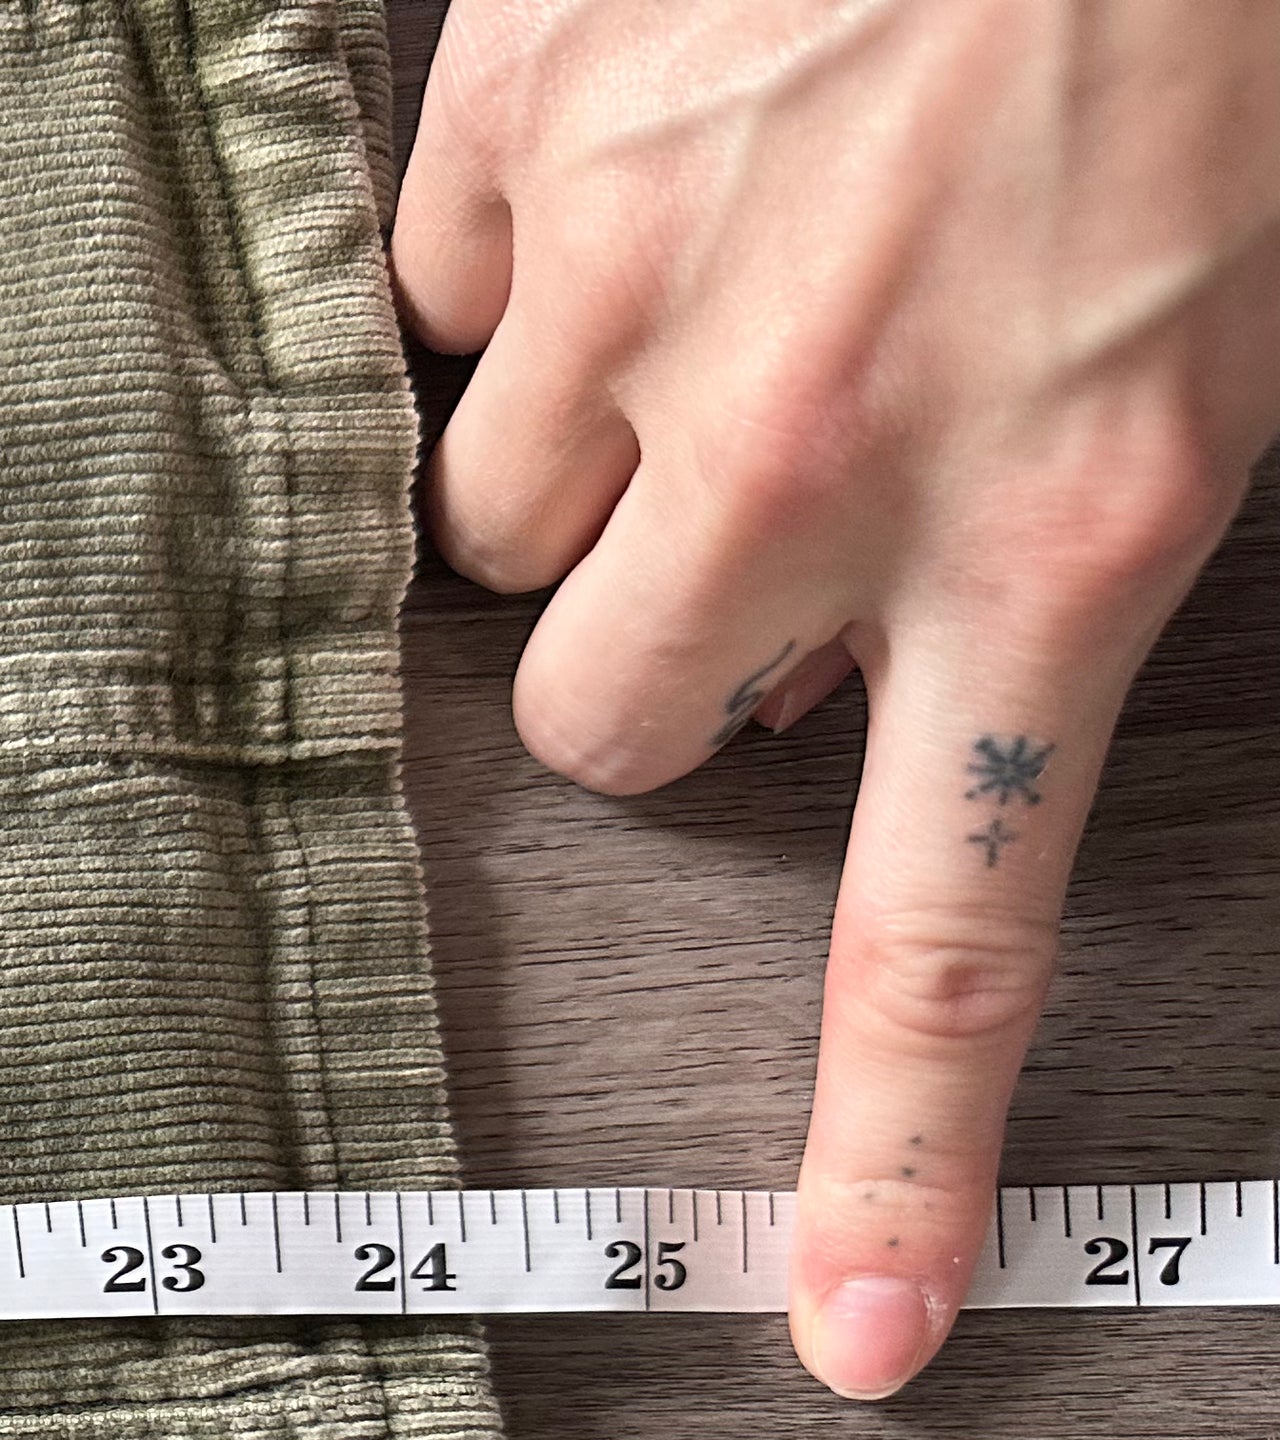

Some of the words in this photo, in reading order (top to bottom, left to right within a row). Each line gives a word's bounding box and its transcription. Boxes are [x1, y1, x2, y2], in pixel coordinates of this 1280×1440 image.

[101, 1243, 206, 1293] 23
[354, 1242, 457, 1293] 24
[603, 1239, 688, 1291] 25
[1084, 1236, 1193, 1286] 27
